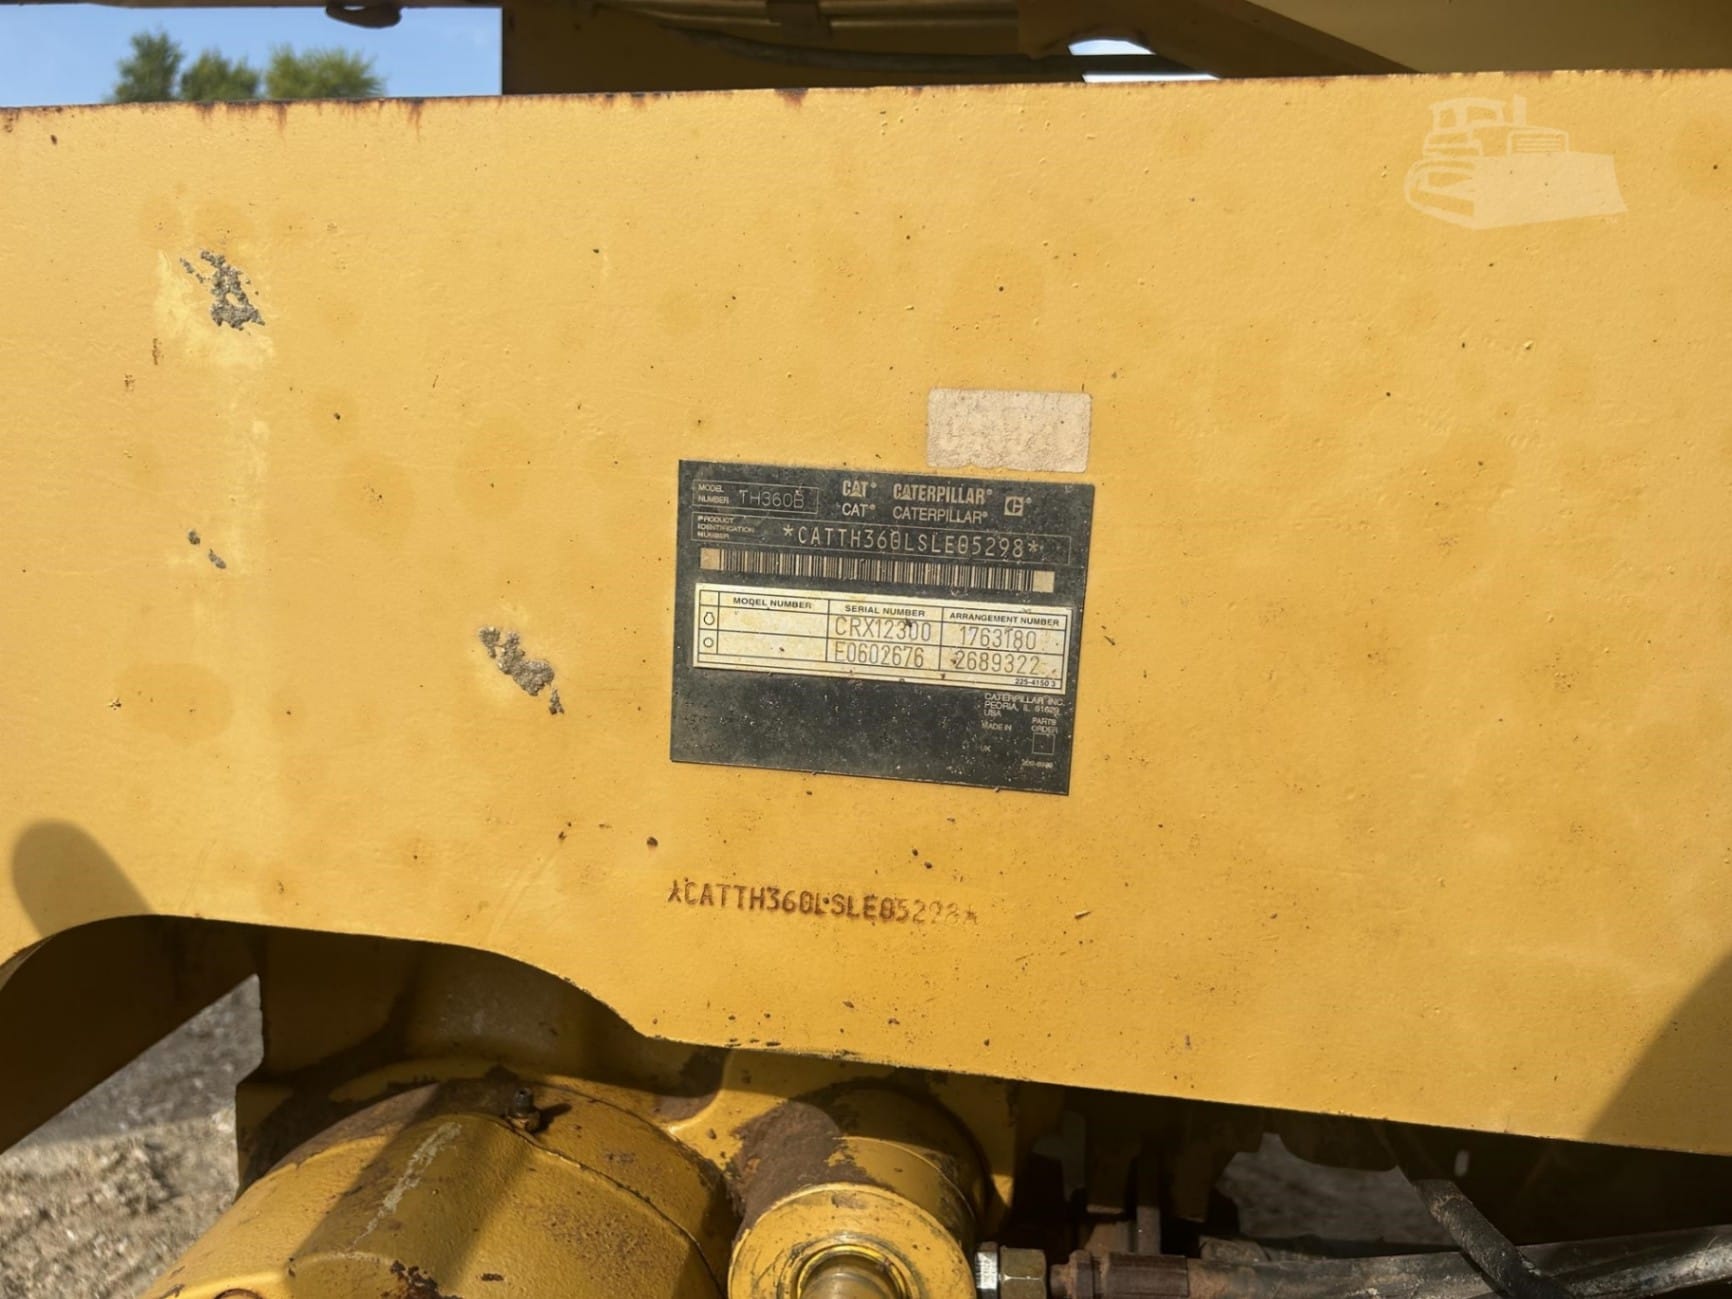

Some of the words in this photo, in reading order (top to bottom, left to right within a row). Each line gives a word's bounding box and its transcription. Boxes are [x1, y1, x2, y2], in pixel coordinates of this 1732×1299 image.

[698, 484, 724, 493] MODEL
[697, 495, 729, 504] NUMBER
[739, 489, 805, 509] TH360B
[697, 515, 734, 524] PRODUCT
[697, 523, 755, 533] IDENTIFICATION
[697, 531, 730, 540] NUMBER
[733, 597, 767, 607] MODEL
[770, 600, 812, 609] NUMBER
[845, 604, 880, 614] SERIAL
[882, 607, 926, 617] NUMBER
[949, 612, 1018, 624] ARRANGEMENT
[1021, 618, 1060, 627] NUMBER
[834, 615, 932, 642] CRX12300
[959, 626, 1037, 650] 1763180
[834, 641, 925, 668] E0602676
[954, 650, 1040, 675] 2689322
[984, 692, 1044, 705] CATERPILLAR
